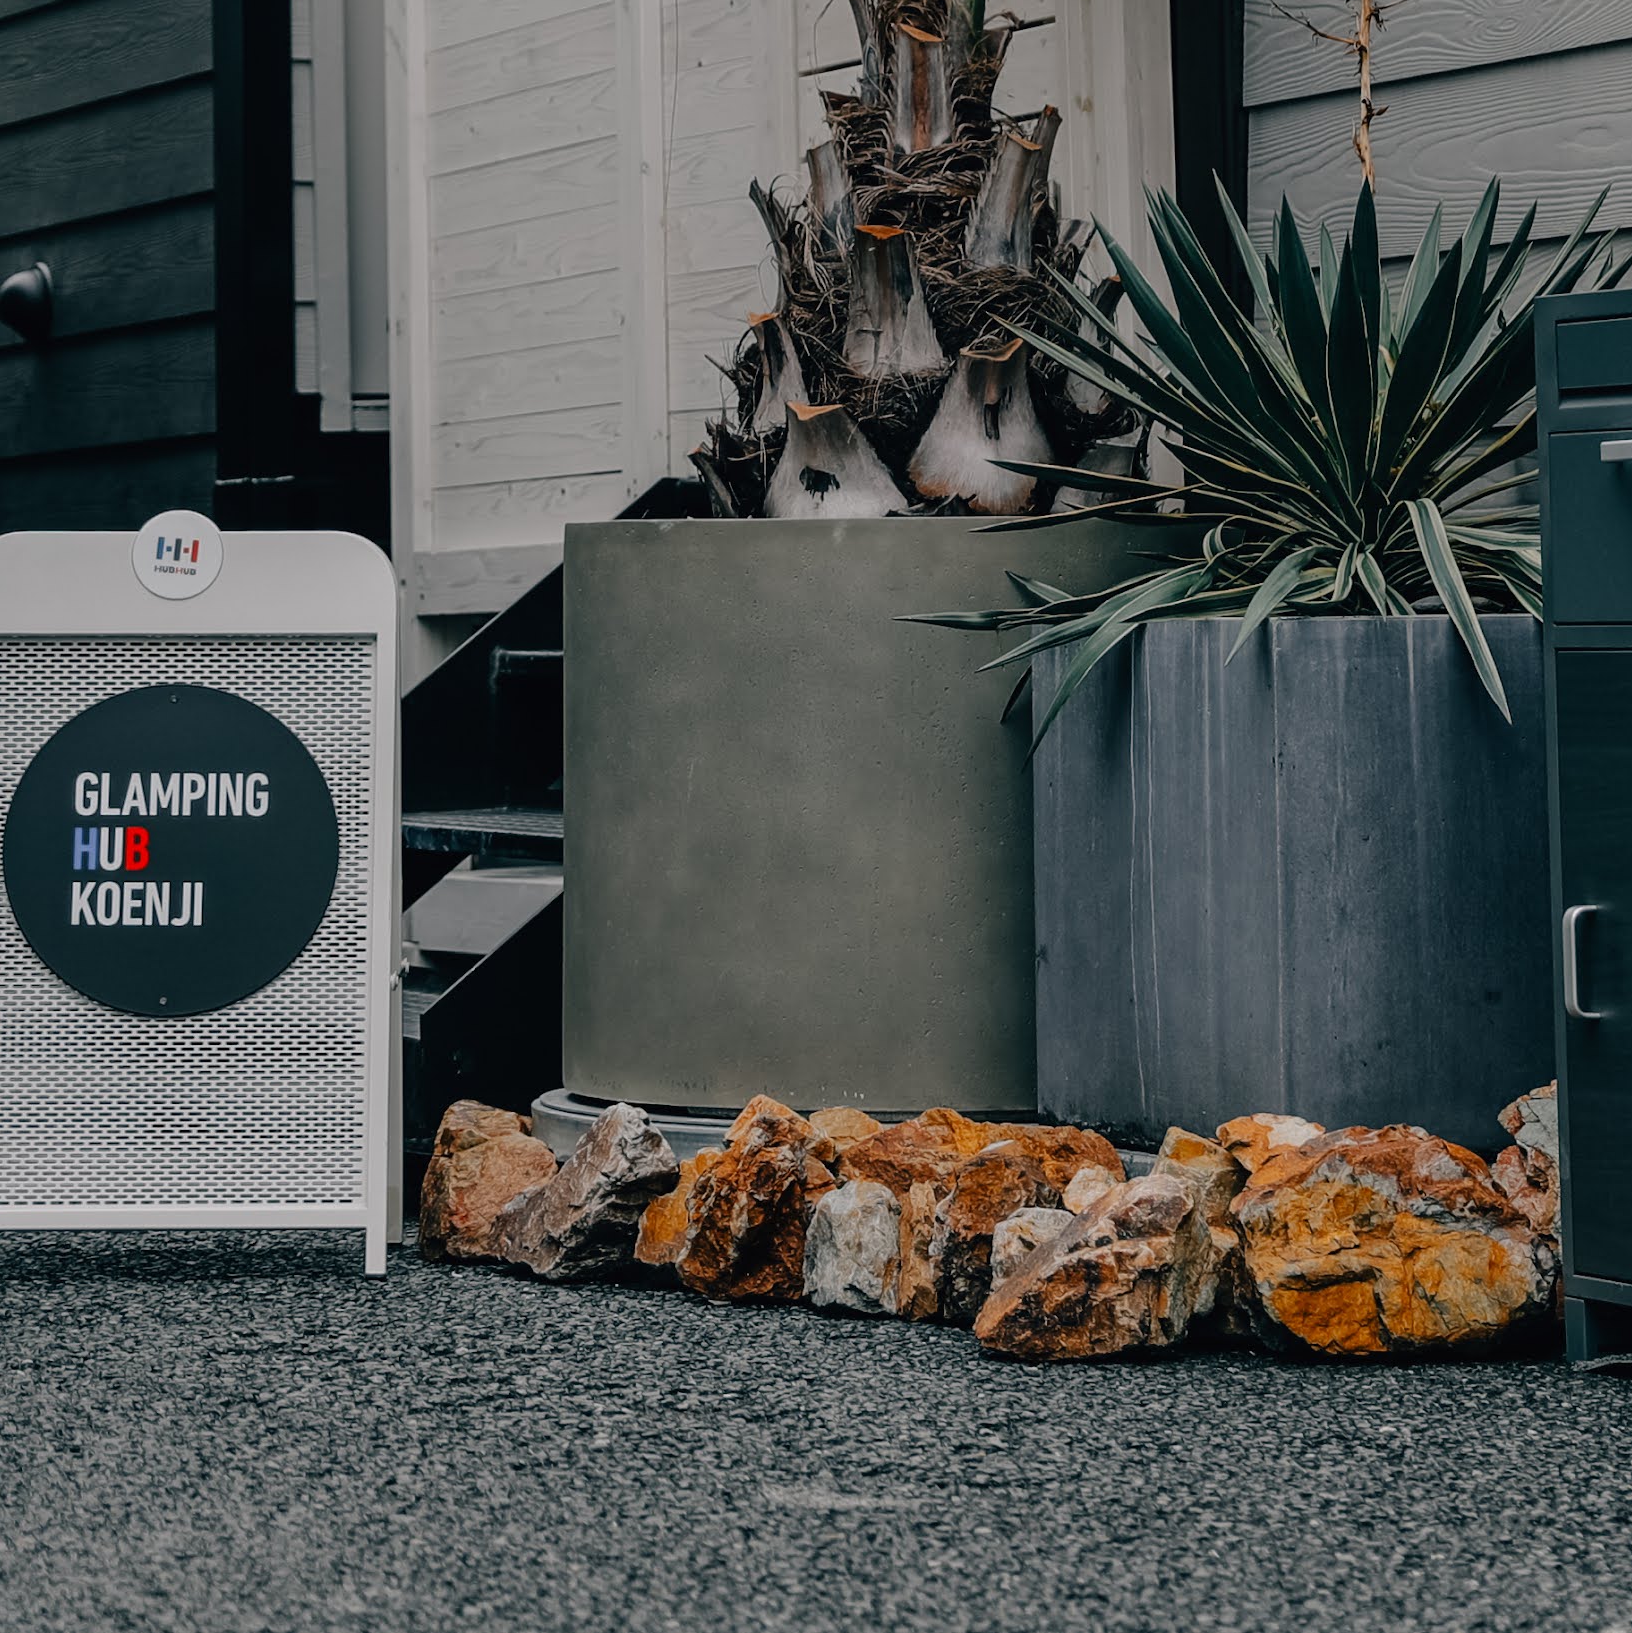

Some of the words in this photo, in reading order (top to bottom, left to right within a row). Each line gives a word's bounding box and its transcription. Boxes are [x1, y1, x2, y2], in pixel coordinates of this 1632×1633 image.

[154, 565, 197, 576] HUBHUB
[74, 771, 270, 818] GLAMPING
[73, 826, 151, 872] HUB
[70, 880, 204, 927] KOENJI
